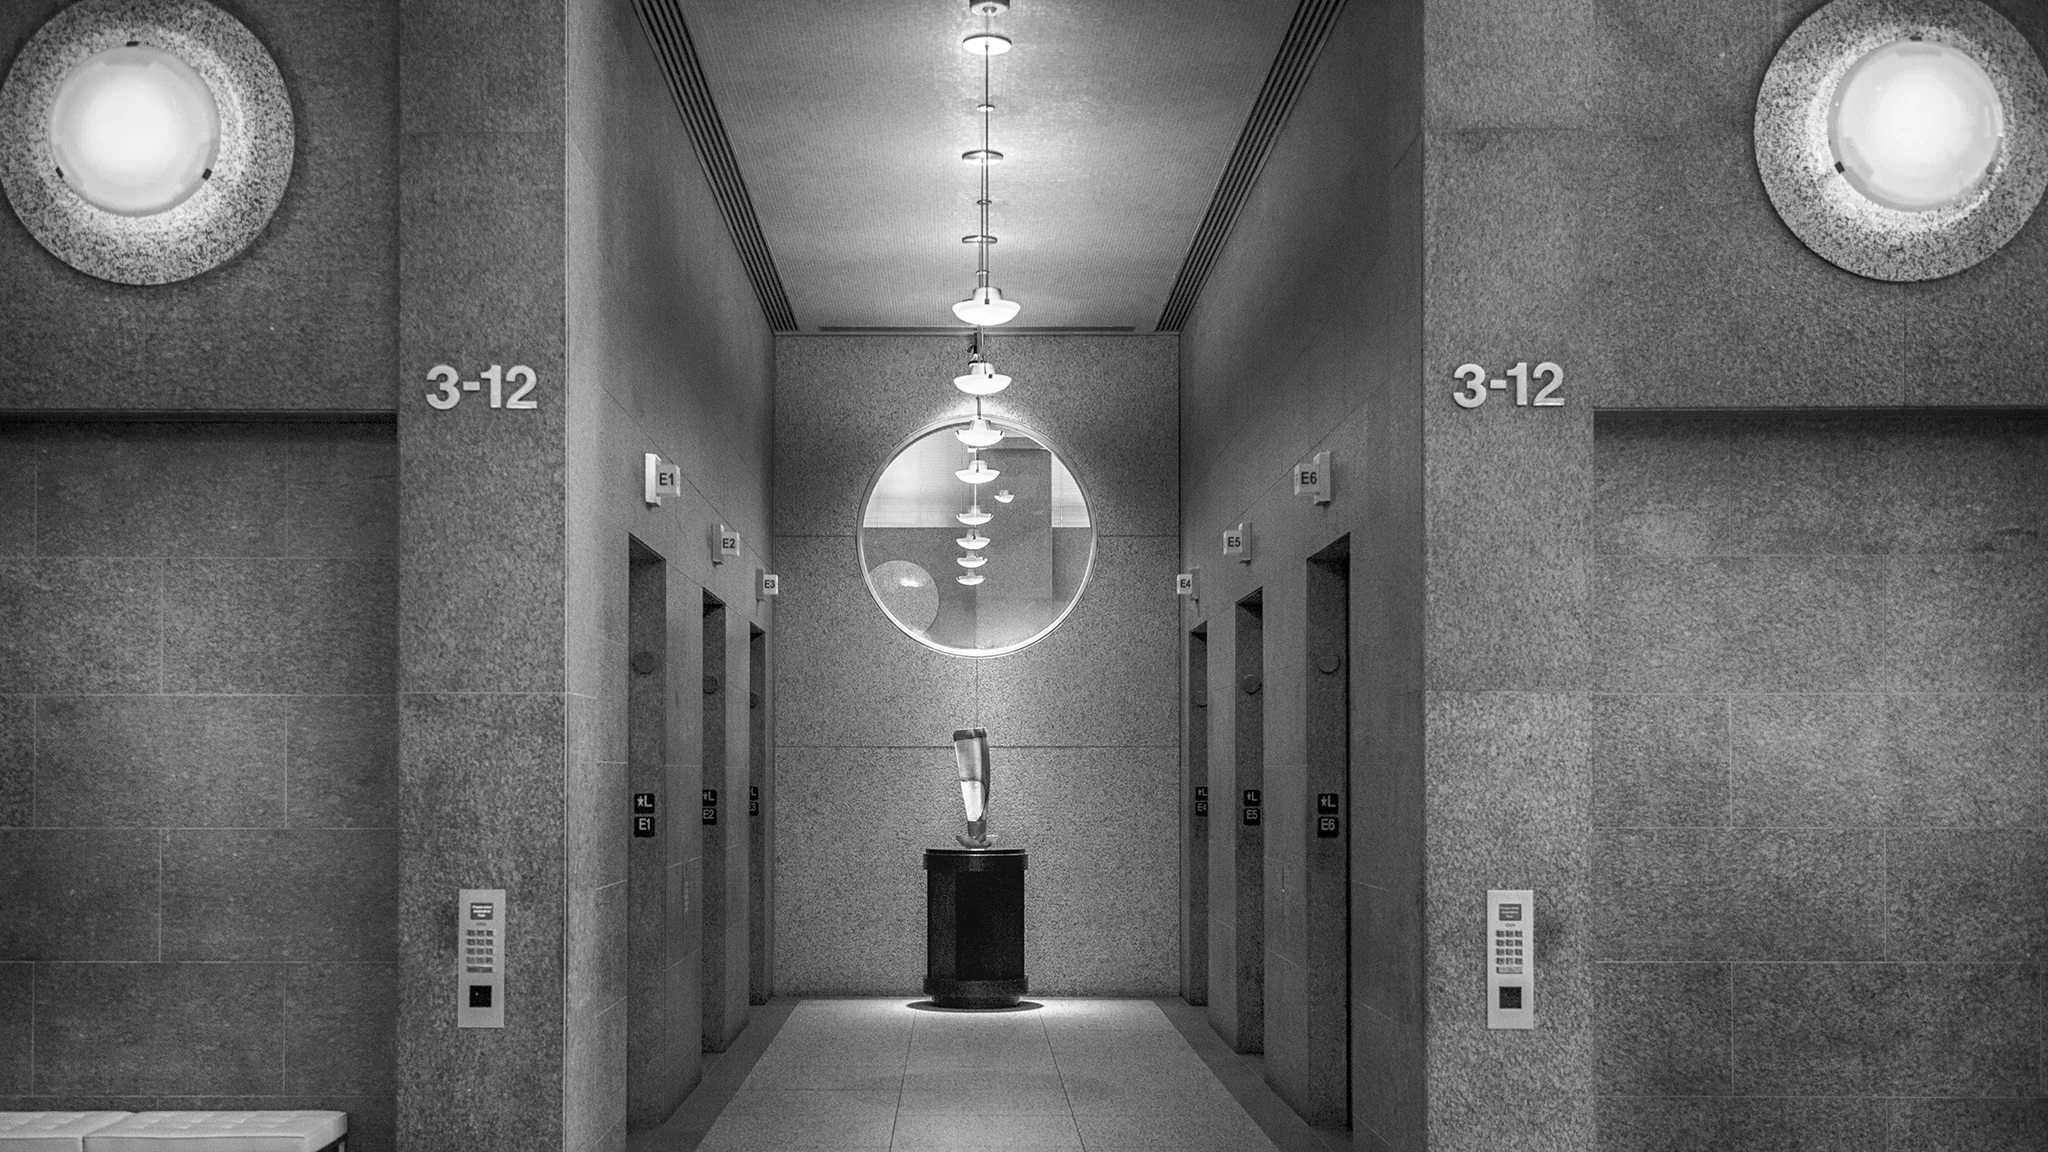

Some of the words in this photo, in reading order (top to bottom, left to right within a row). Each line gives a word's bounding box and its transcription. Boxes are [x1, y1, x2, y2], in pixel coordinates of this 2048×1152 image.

[426, 364, 538, 410] 3-12
[1453, 362, 1565, 408] 3-12
[659, 472, 674, 486] E1
[1301, 471, 1317, 485] E6
[722, 538, 736, 549] E2
[1227, 536, 1241, 548] E5
[764, 579, 776, 589] E3
[1180, 579, 1191, 588] E4
[703, 809, 715, 819] E2
[1246, 810, 1258, 820] E5
[639, 818, 651, 830] E1
[1321, 818, 1335, 831] E6
